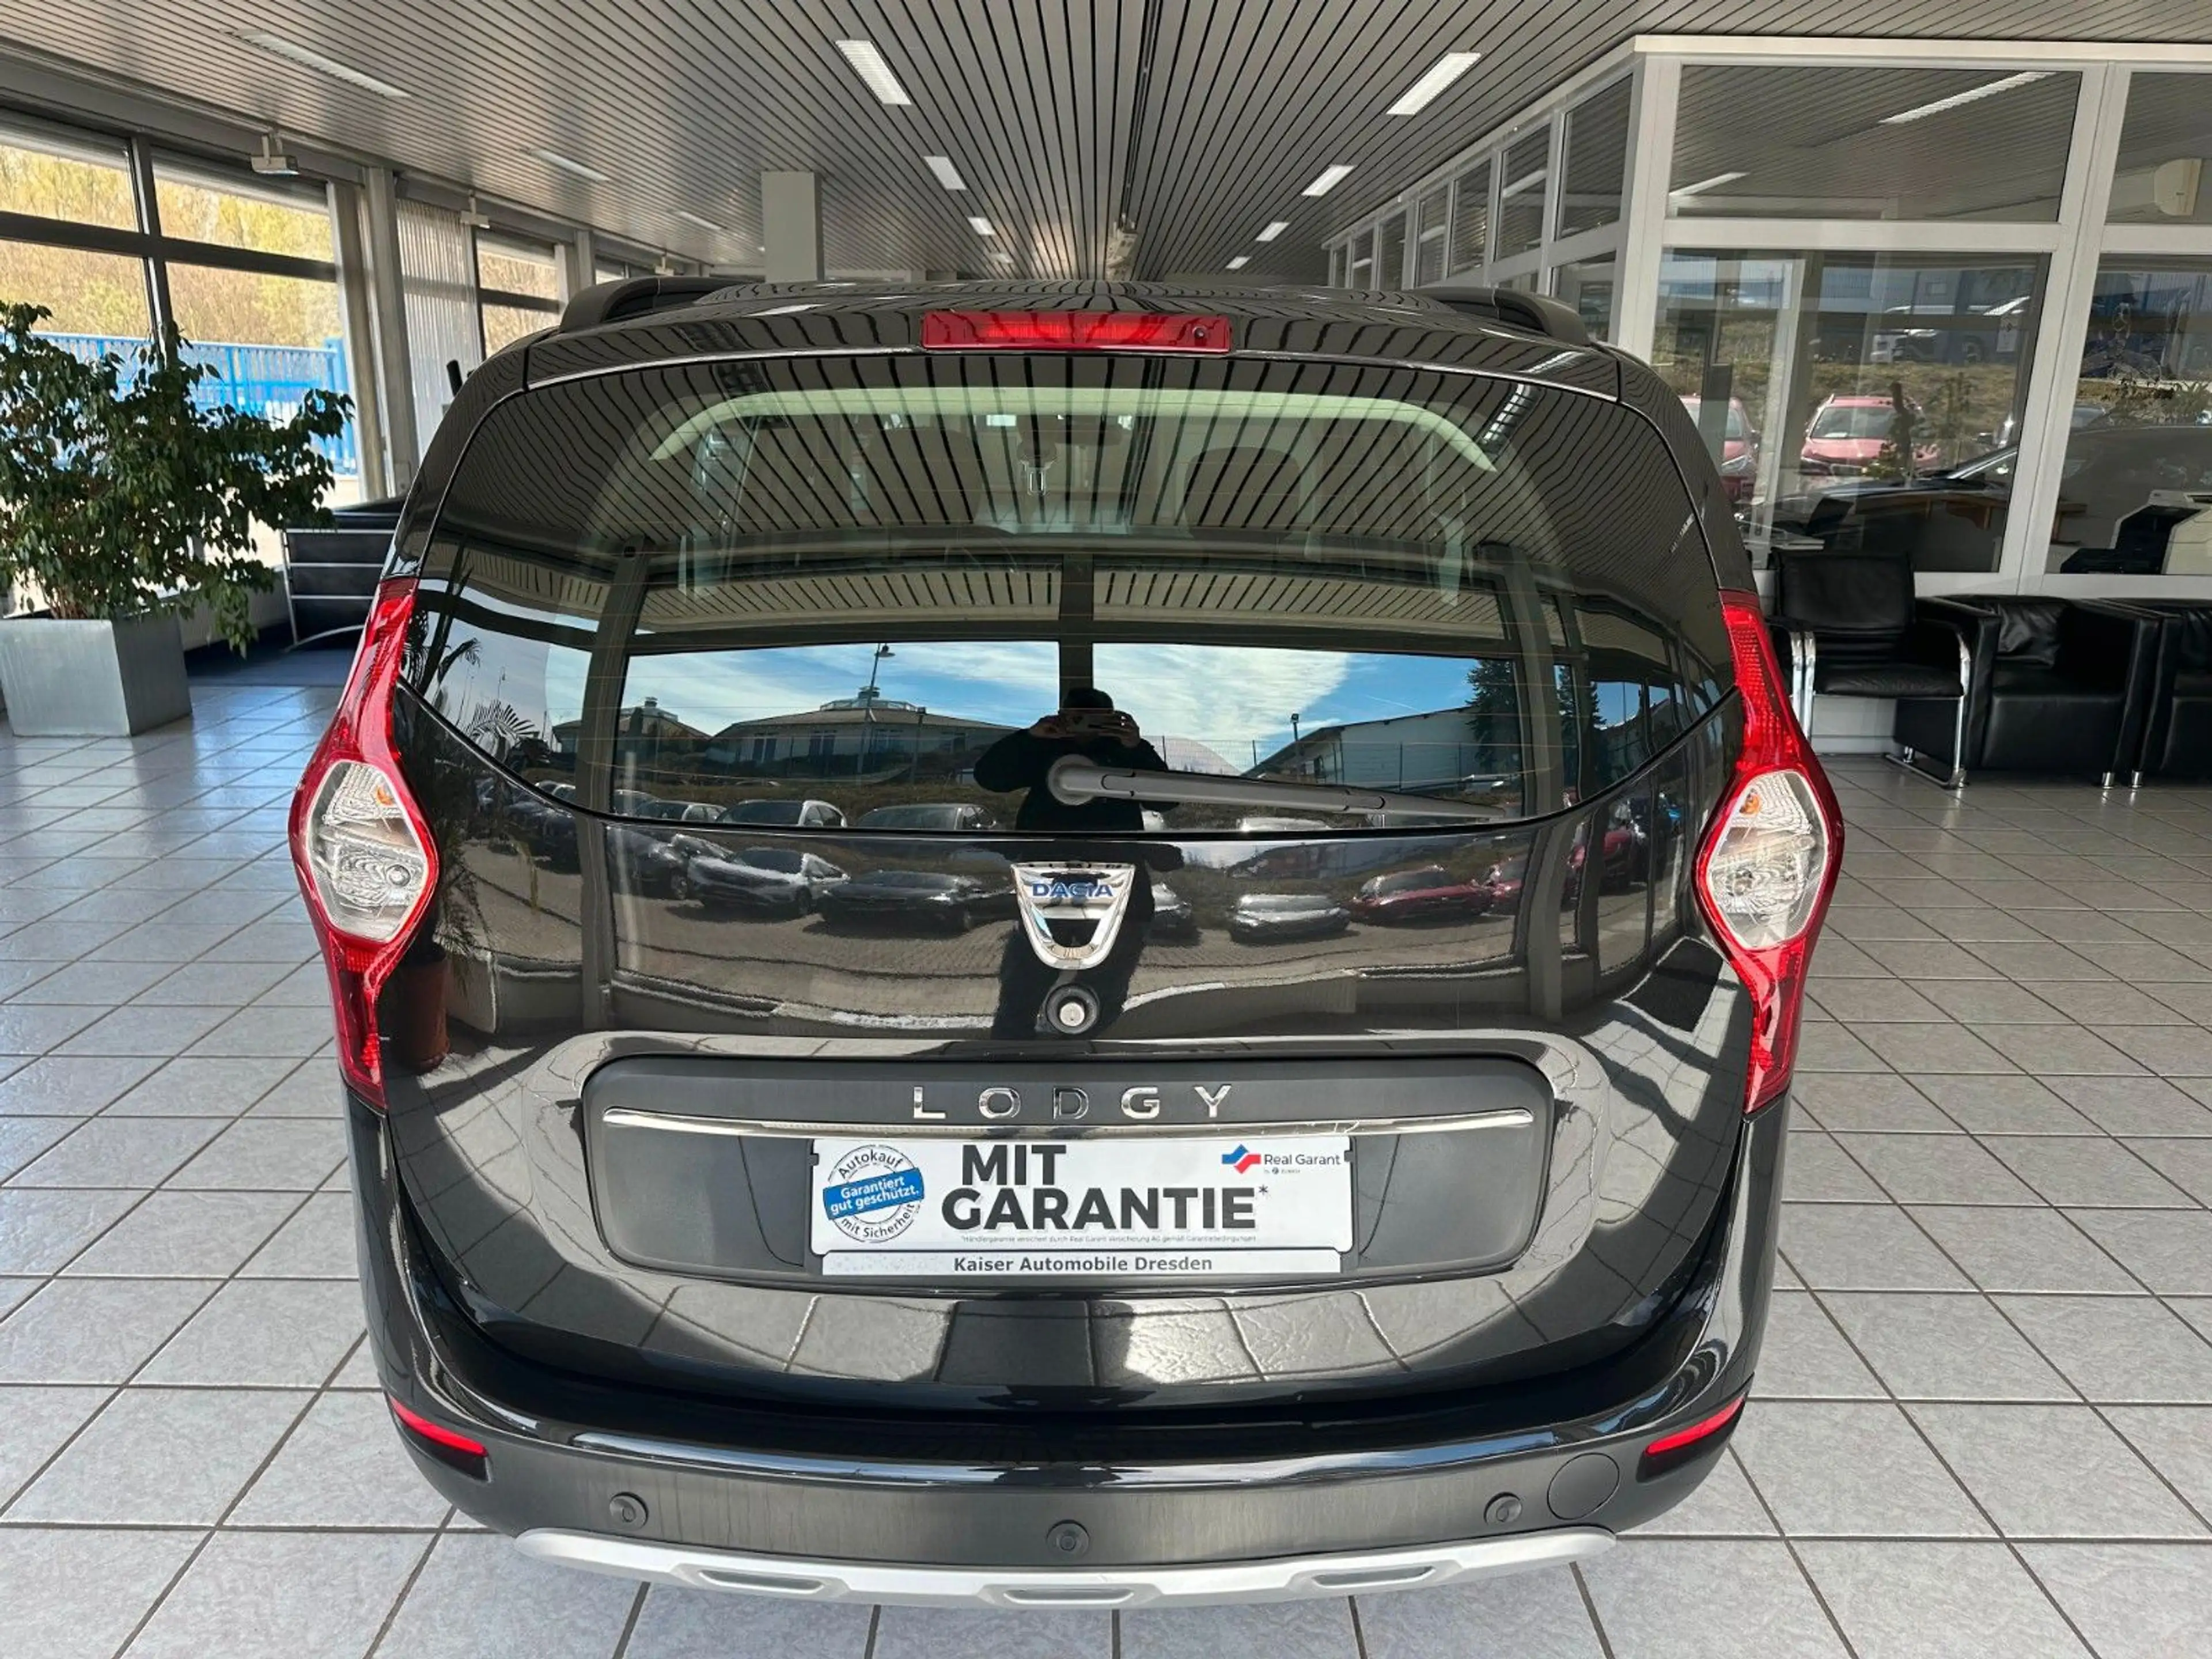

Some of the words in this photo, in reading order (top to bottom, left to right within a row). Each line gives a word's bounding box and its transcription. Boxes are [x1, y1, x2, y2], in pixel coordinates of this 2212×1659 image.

[1032, 882, 1114, 897] DACIA
[913, 1085, 1232, 1120] LODGY
[838, 1149, 903, 1179] Autokauf
[962, 1144, 1067, 1185] MIT
[1264, 1154, 1292, 1165] Real
[1295, 1154, 1342, 1165] Garant
[830, 1198, 854, 1215] gut
[855, 1184, 920, 1210] geschützt.
[840, 1176, 906, 1199] Garantiert
[840, 1217, 861, 1235] mit
[862, 1203, 915, 1238] Sicherheit
[954, 1257, 1014, 1272] Kaiser
[1019, 1256, 1128, 1271] Automobile
[1135, 1256, 1213, 1271] Dresden
